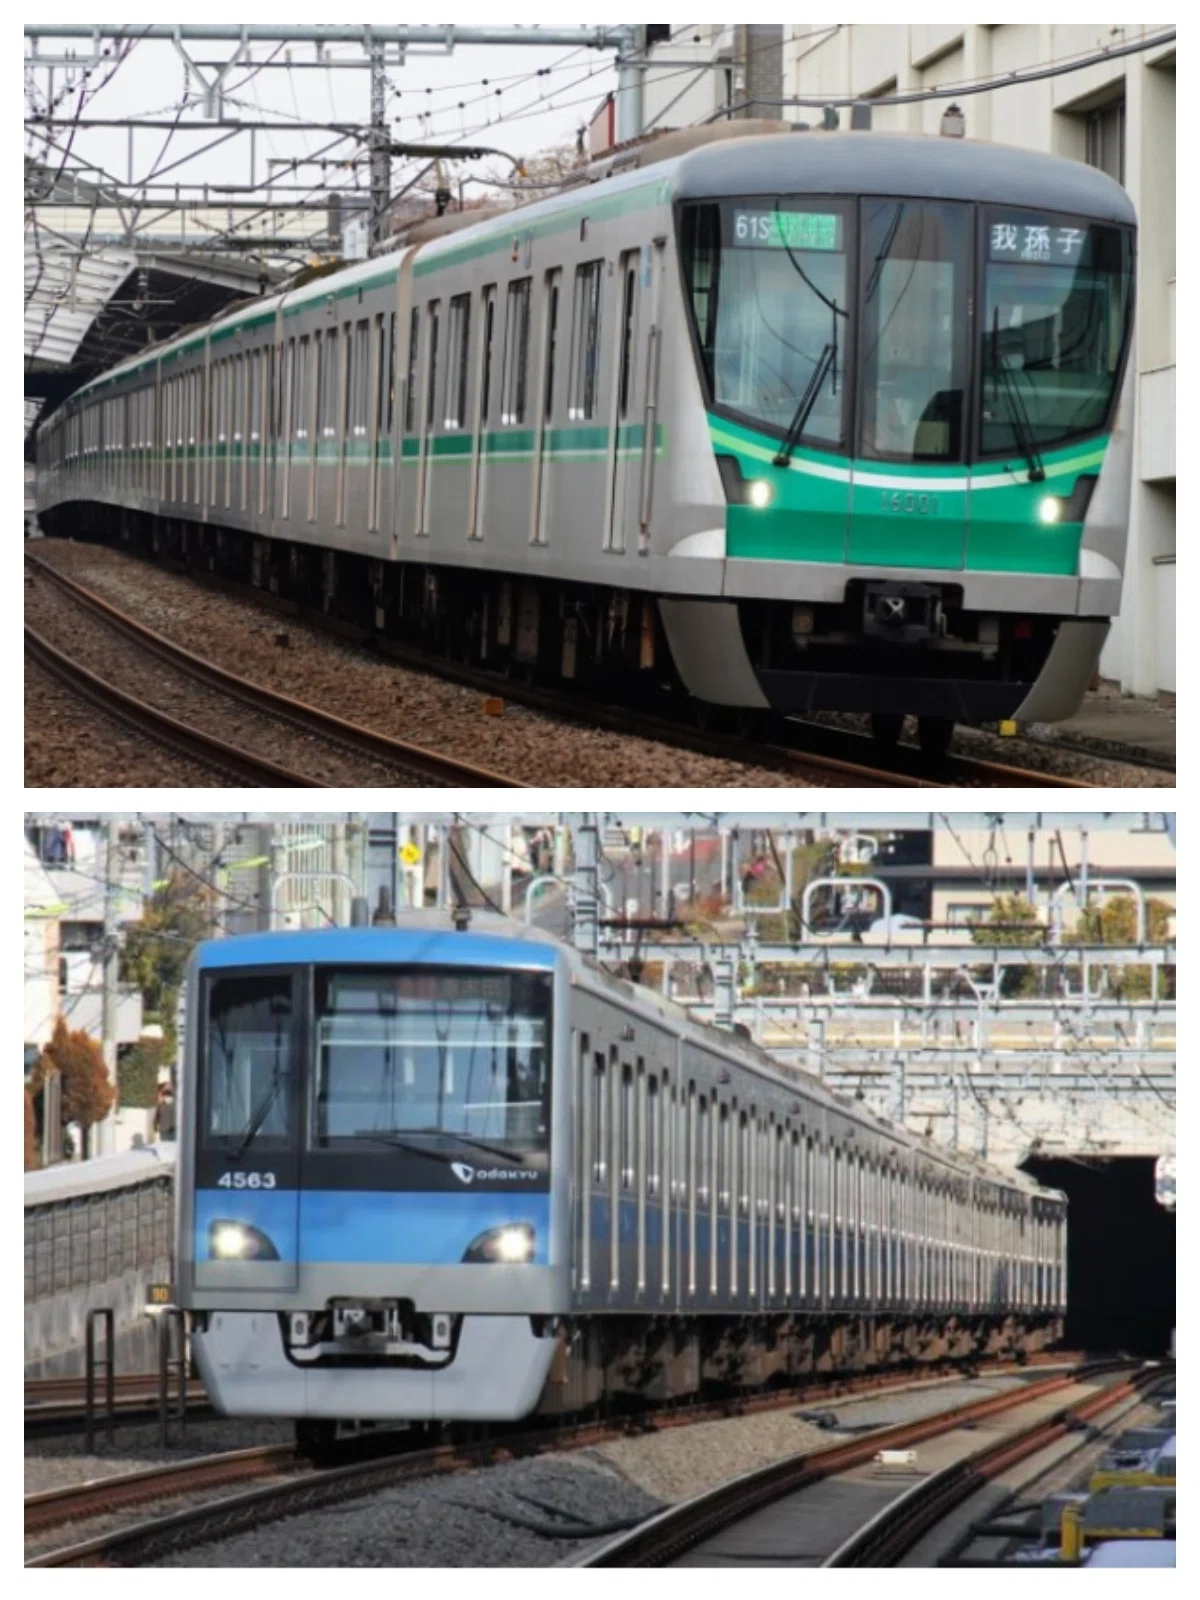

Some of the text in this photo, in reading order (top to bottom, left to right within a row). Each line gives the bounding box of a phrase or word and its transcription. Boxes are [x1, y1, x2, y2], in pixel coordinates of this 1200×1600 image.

[736, 215, 769, 239] 61S
[990, 224, 1082, 254] 我孫子
[217, 1171, 276, 1189] 4563
